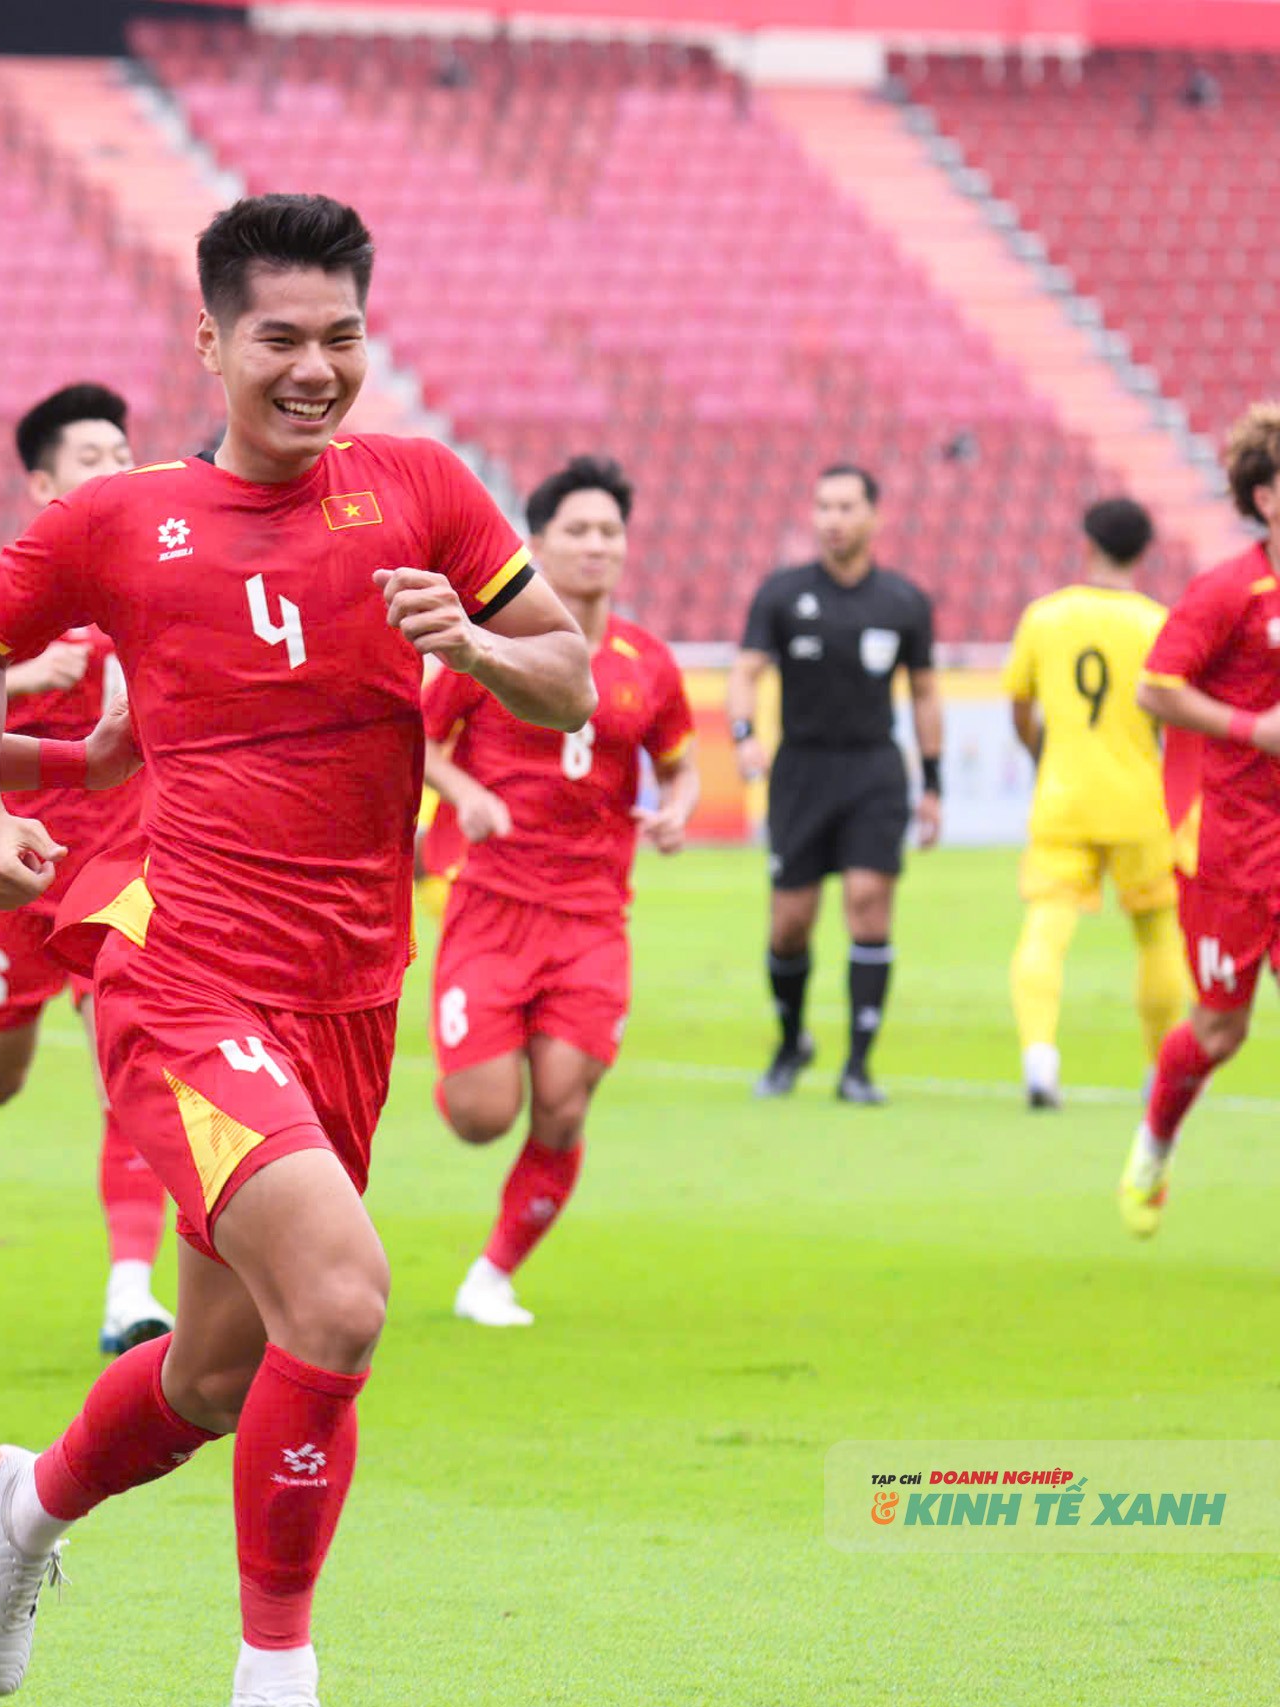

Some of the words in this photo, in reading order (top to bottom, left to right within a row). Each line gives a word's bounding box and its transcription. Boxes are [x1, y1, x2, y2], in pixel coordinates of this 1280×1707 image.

[245, 573, 307, 670] 4
[1075, 647, 1108, 727] 9
[1197, 936, 1237, 995] 14
[217, 1036, 289, 1087] 4
